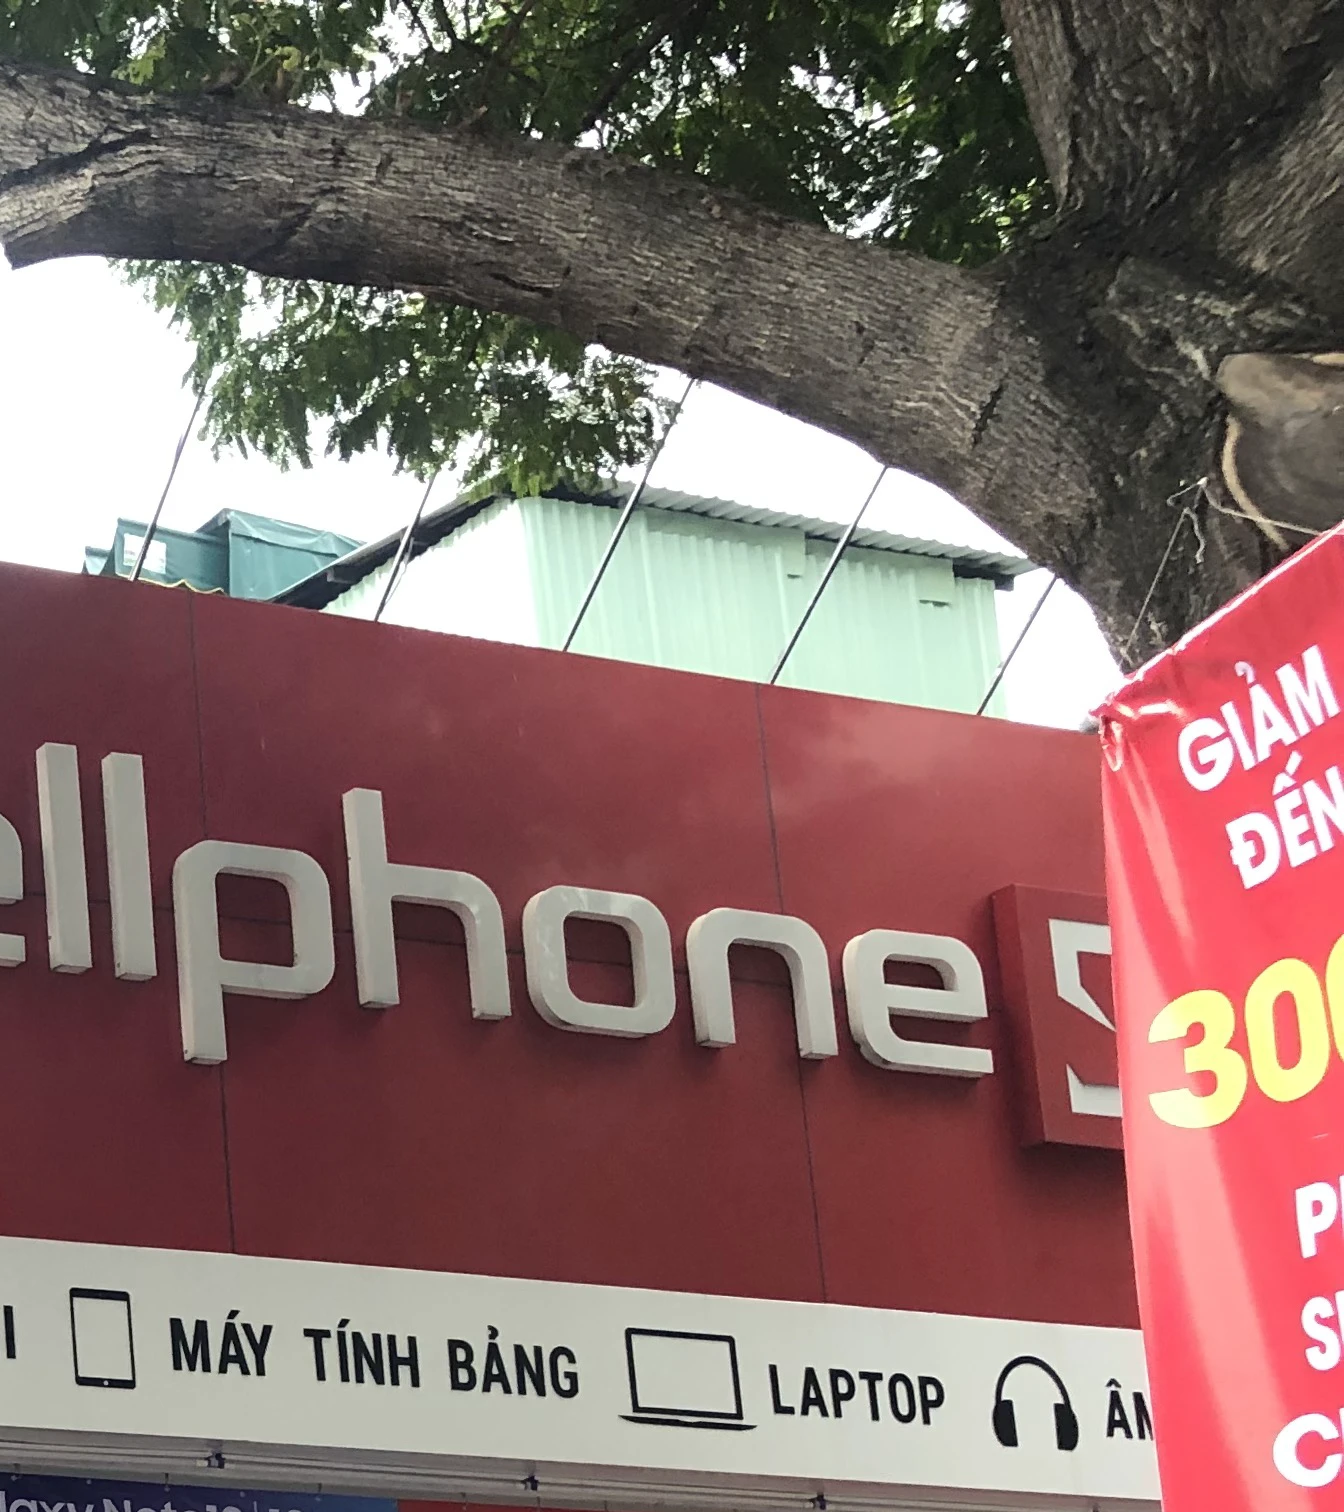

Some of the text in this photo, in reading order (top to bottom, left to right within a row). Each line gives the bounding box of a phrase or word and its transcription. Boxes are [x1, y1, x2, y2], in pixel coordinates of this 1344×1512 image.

[1177, 644, 1341, 792] GIẢM
[1147, 932, 1344, 1129] 30
[169, 1308, 580, 1400] MÁY TÍNH BẢNG
[768, 1362, 947, 1427] LAPTOP
